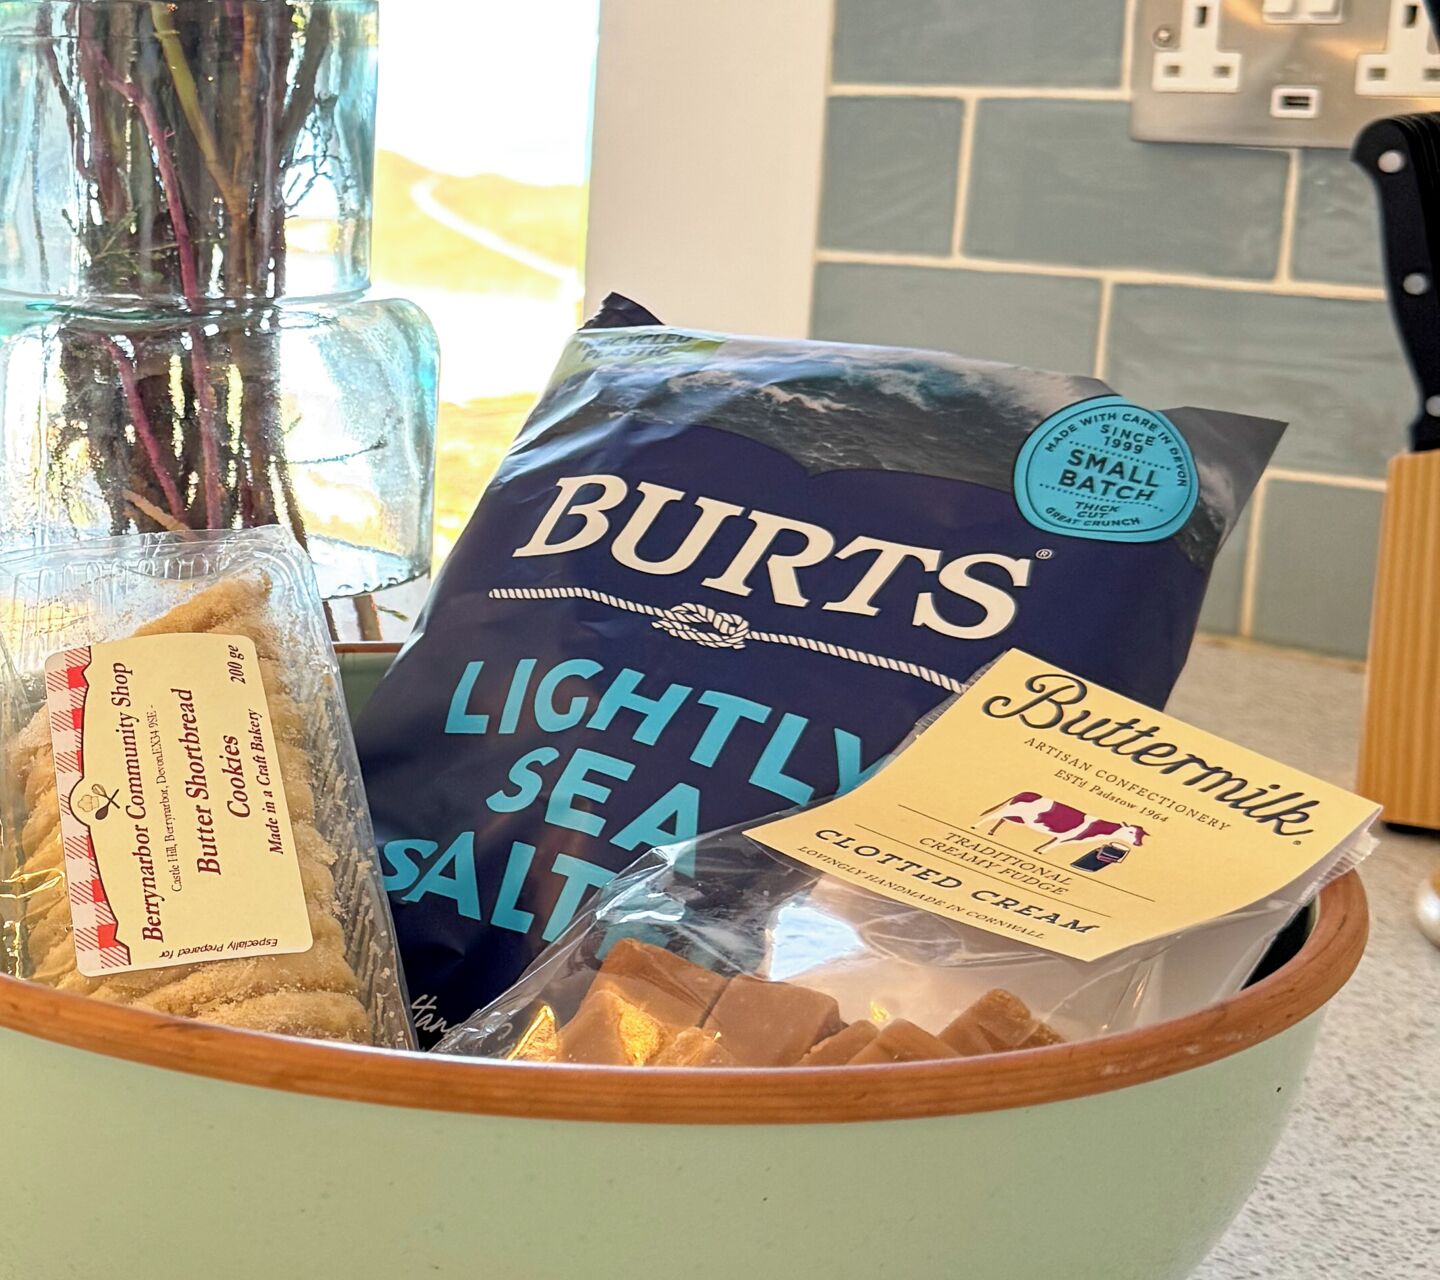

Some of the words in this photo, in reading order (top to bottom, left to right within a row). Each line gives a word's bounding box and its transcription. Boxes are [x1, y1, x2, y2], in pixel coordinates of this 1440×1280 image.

[1045, 424, 1077, 452] MADE
[1080, 413, 1117, 426] WITH
[1123, 414, 1158, 431] CARE
[1158, 432, 1171, 444] IN
[1170, 447, 1187, 487] DEVON
[1100, 425, 1156, 446] SINCE
[1104, 436, 1143, 454] 1999
[1059, 469, 1155, 501] BATCH
[1067, 449, 1160, 488] SMALL
[1045, 507, 1080, 526] GREAT
[1083, 518, 1140, 526] CRUNCH
[1075, 501, 1121, 512] THICK
[512, 474, 1034, 639] BURTS
[110, 662, 133, 707] Shop
[227, 661, 246, 684] 200
[146, 710, 158, 728] 9SE
[248, 708, 264, 753] Bakery
[117, 712, 147, 819] Community
[170, 688, 209, 800] Shortbread
[982, 674, 1320, 836] Buttermilk
[219, 735, 250, 818] Cookies
[253, 755, 271, 785] Craft
[1024, 737, 1092, 771] ARTISAN
[1095, 769, 1232, 832] CONFECTIONERY
[160, 786, 175, 842] Berrynarbor,
[262, 799, 277, 815] in
[486, 746, 701, 877] SEA
[1089, 784, 1137, 810] Padstow
[1140, 807, 1169, 823] 1964
[196, 805, 221, 875] Butter
[265, 818, 284, 854] Made
[169, 865, 182, 892] Castle
[815, 829, 963, 889] CLOTTED
[971, 889, 1100, 934] CREAM
[919, 836, 1003, 875] CREAMY
[999, 864, 1070, 896] FUDGE
[944, 832, 1074, 886] TRADITIONAL
[132, 824, 165, 942] Berrynarbor
[384, 831, 645, 950] SALT
[797, 845, 865, 877] LOVINGLY
[864, 874, 947, 906] HANDMADE
[948, 902, 965, 913] IN
[964, 911, 1046, 939] CORNWALL
[159, 951, 174, 959] for
[177, 944, 223, 957] Prepared
[227, 938, 278, 950] Especially
